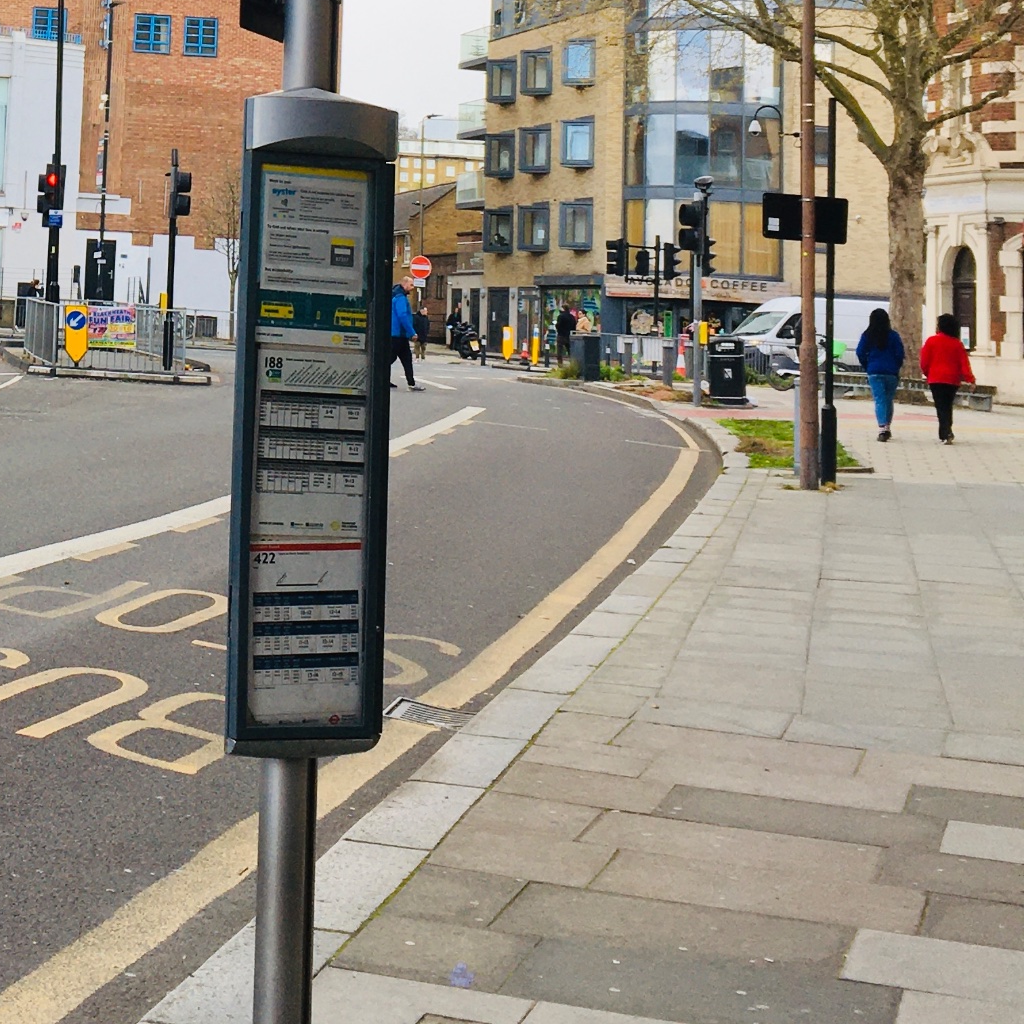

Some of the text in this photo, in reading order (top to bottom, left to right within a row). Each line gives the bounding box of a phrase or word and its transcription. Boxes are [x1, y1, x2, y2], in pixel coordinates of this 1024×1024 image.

[272, 187, 297, 197] oyster
[710, 279, 769, 293] COFFEE
[93, 309, 131, 318] BLACKHEATH
[89, 315, 131, 325] FUN FAIR
[264, 356, 284, 369] 188
[253, 552, 276, 564] 422
